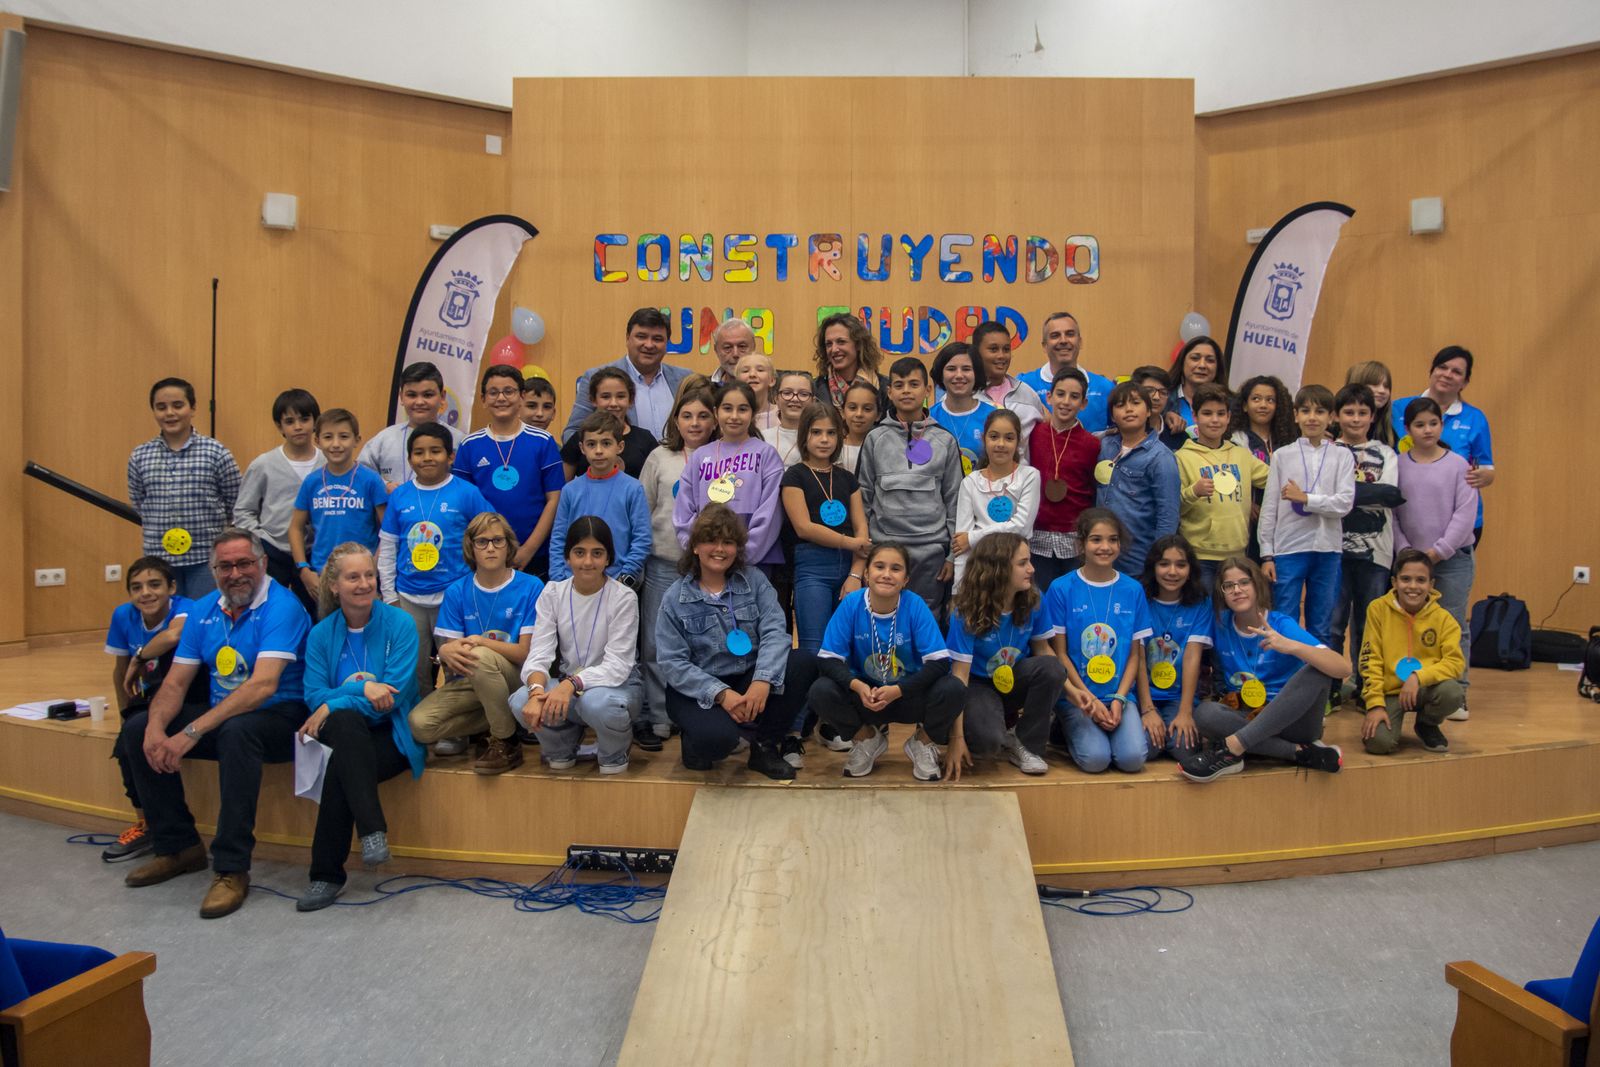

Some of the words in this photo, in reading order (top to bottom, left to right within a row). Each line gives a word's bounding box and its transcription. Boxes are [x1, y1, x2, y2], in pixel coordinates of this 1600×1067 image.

[593, 233, 1101, 284] CONSTRUYENDO
[419, 328, 466, 345] Ayuntamiento
[1245, 321, 1290, 336] Ayuntamiento
[416, 337, 473, 363] HUELVA
[1243, 330, 1297, 355] HUELVA
[312, 497, 364, 509] BENETTON
